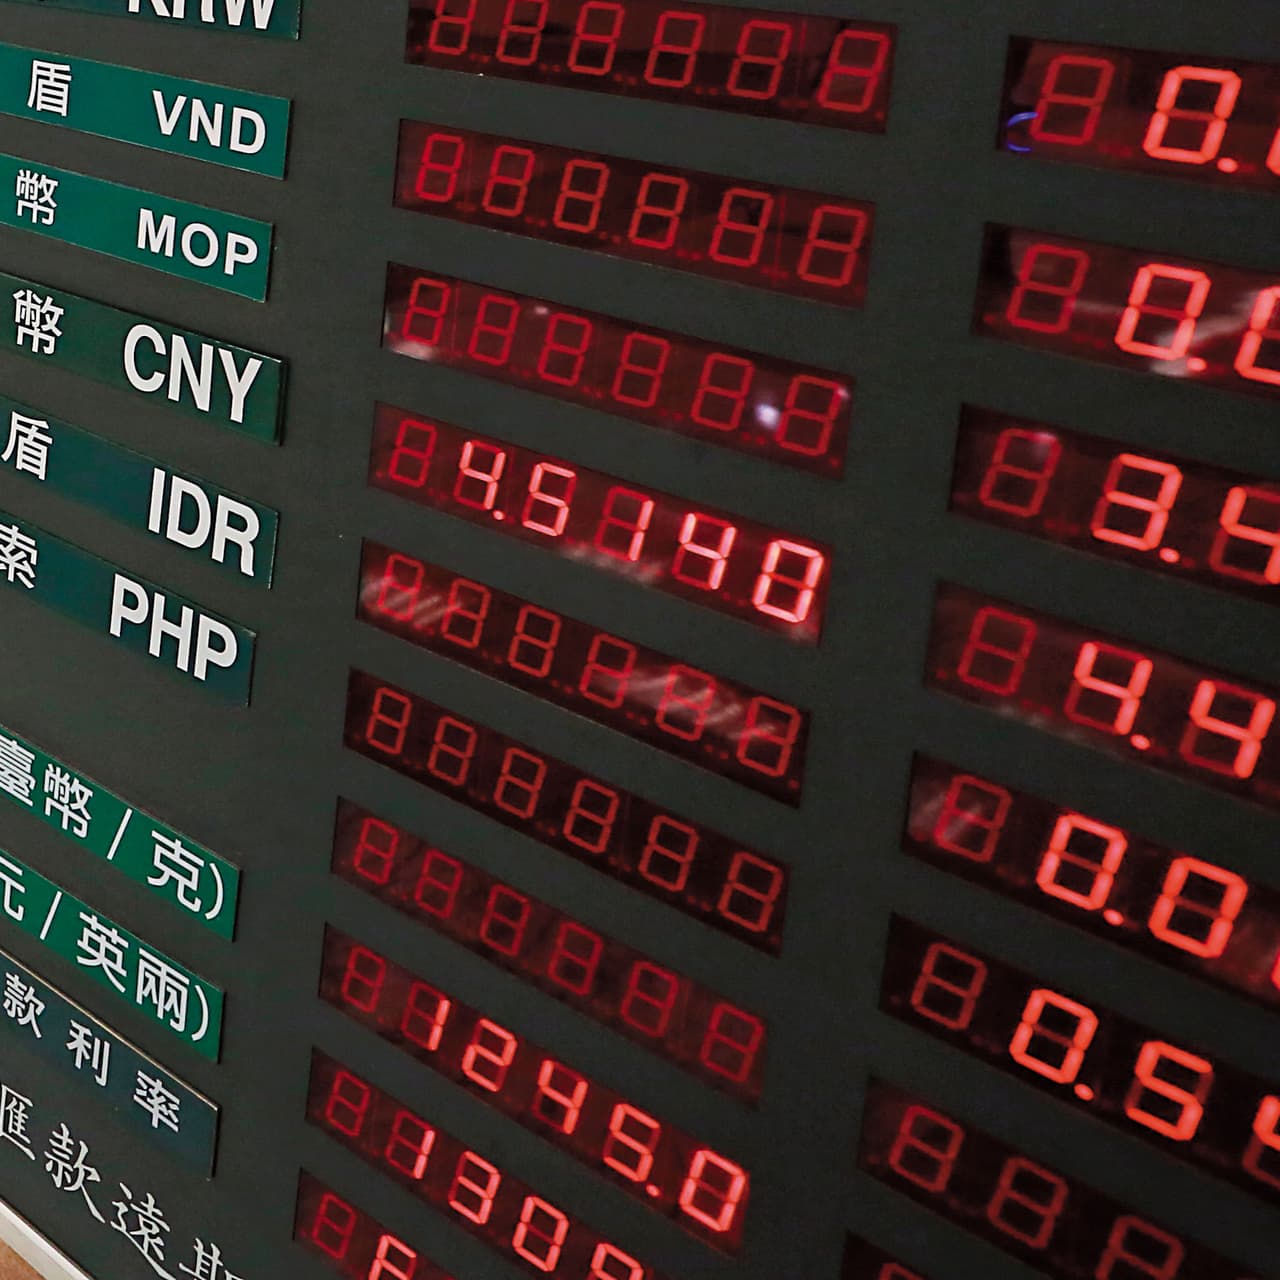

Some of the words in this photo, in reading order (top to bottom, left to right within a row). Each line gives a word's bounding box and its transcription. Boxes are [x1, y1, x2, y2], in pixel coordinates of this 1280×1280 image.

[152, 89, 266, 154] VND
[137, 208, 258, 276] MOP
[124, 324, 264, 424] CNY
[148, 467, 260, 577] IDR
[459, 441, 824, 623] 4.5140
[109, 573, 238, 681] PHP
